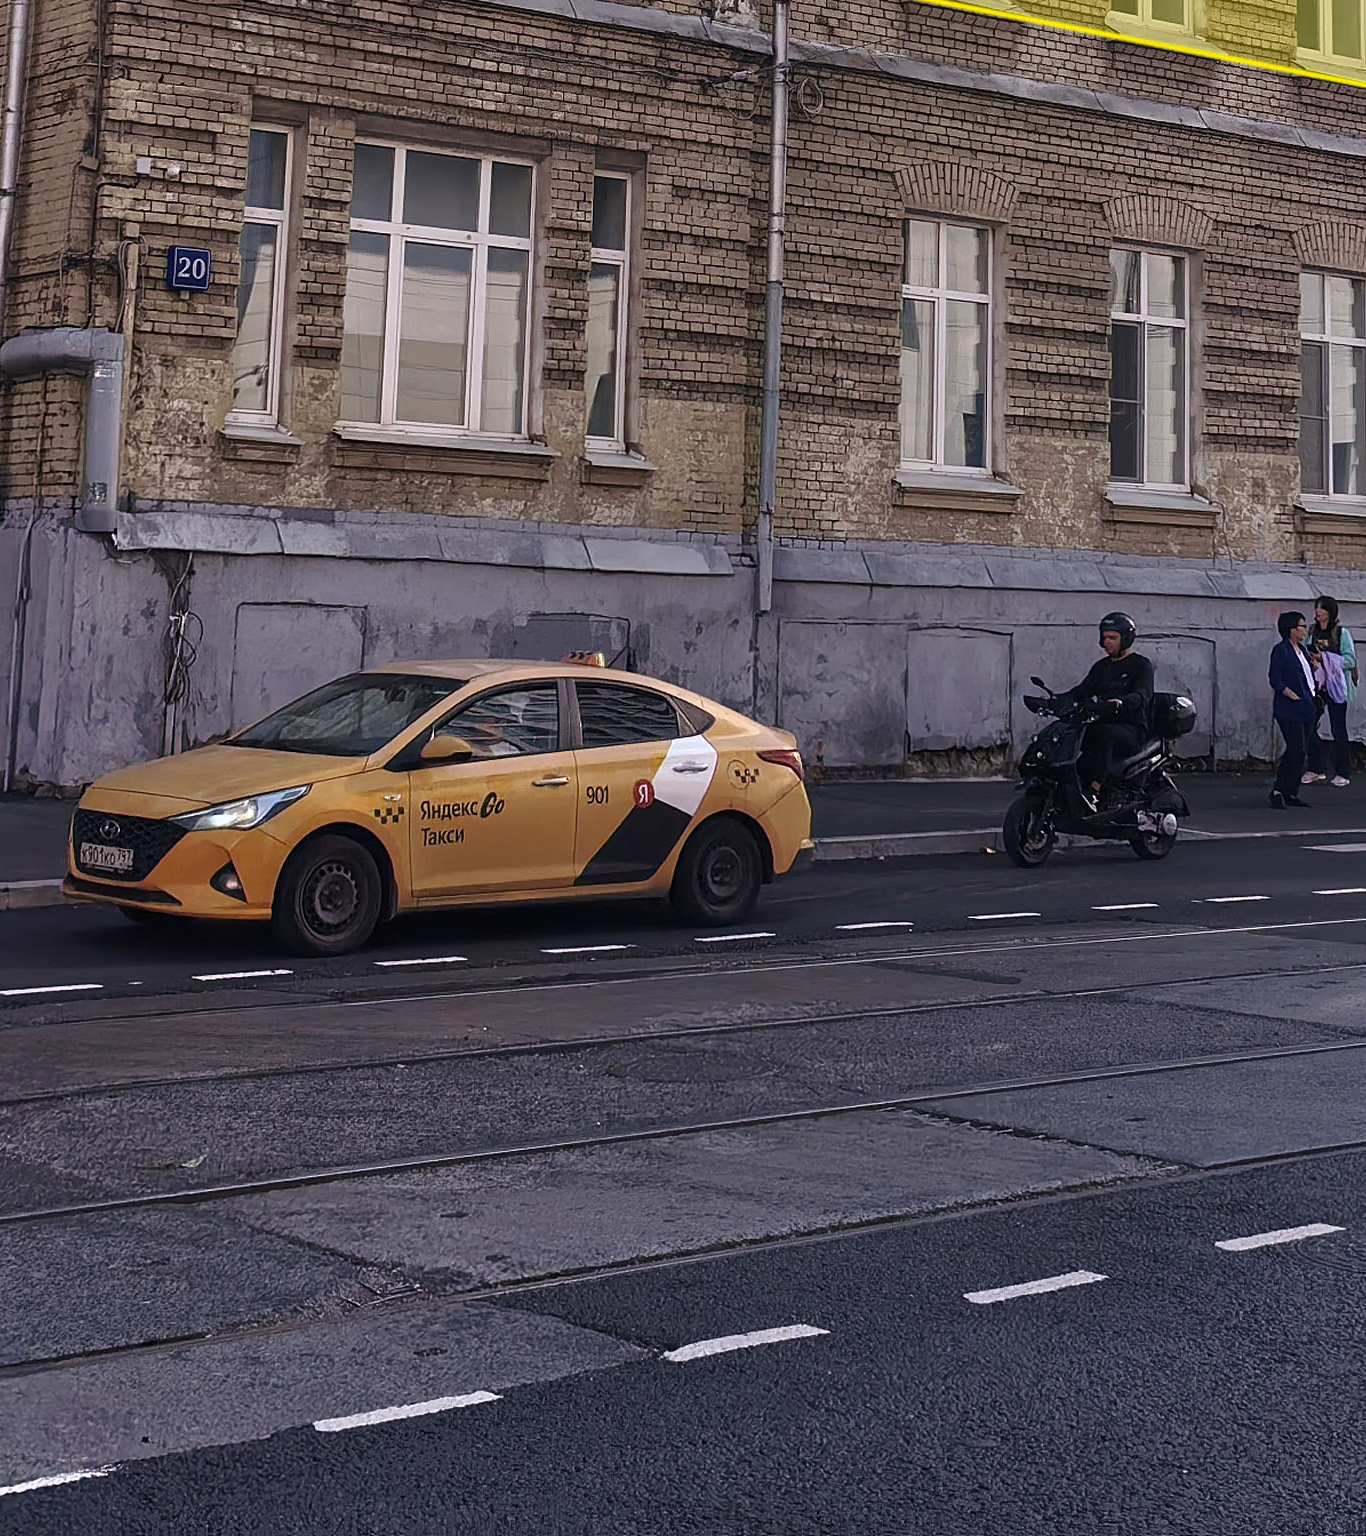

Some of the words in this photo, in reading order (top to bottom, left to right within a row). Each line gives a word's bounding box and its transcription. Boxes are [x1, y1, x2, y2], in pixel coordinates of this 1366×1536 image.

[177, 256, 206, 280] 20
[586, 784, 609, 805] 901
[638, 783, 648, 804] Я
[420, 801, 478, 821] Яндекс
[480, 791, 505, 818] Go
[421, 827, 465, 847] Такси
